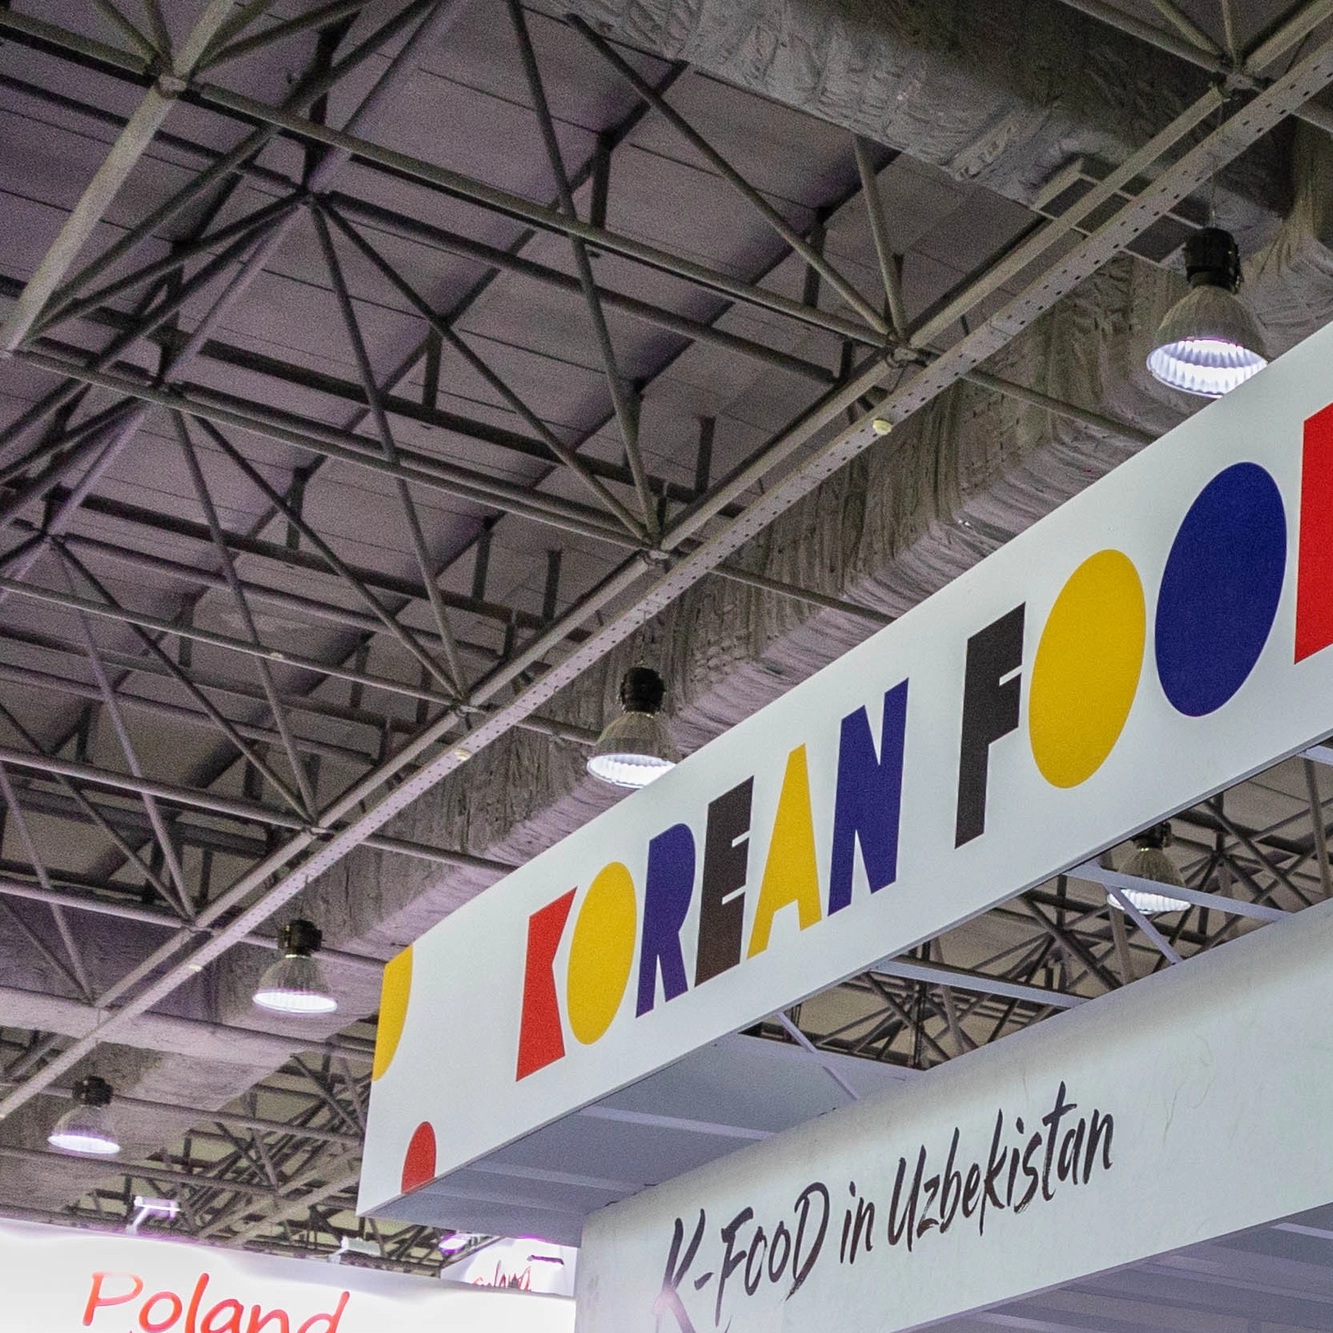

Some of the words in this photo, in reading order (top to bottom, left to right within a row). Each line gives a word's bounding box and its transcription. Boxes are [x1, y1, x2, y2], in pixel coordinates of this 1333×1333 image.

[515, 677, 909, 1082] KOREAN
[840, 1181, 876, 1265] in
[887, 1080, 1114, 1253] Uzbekistan
